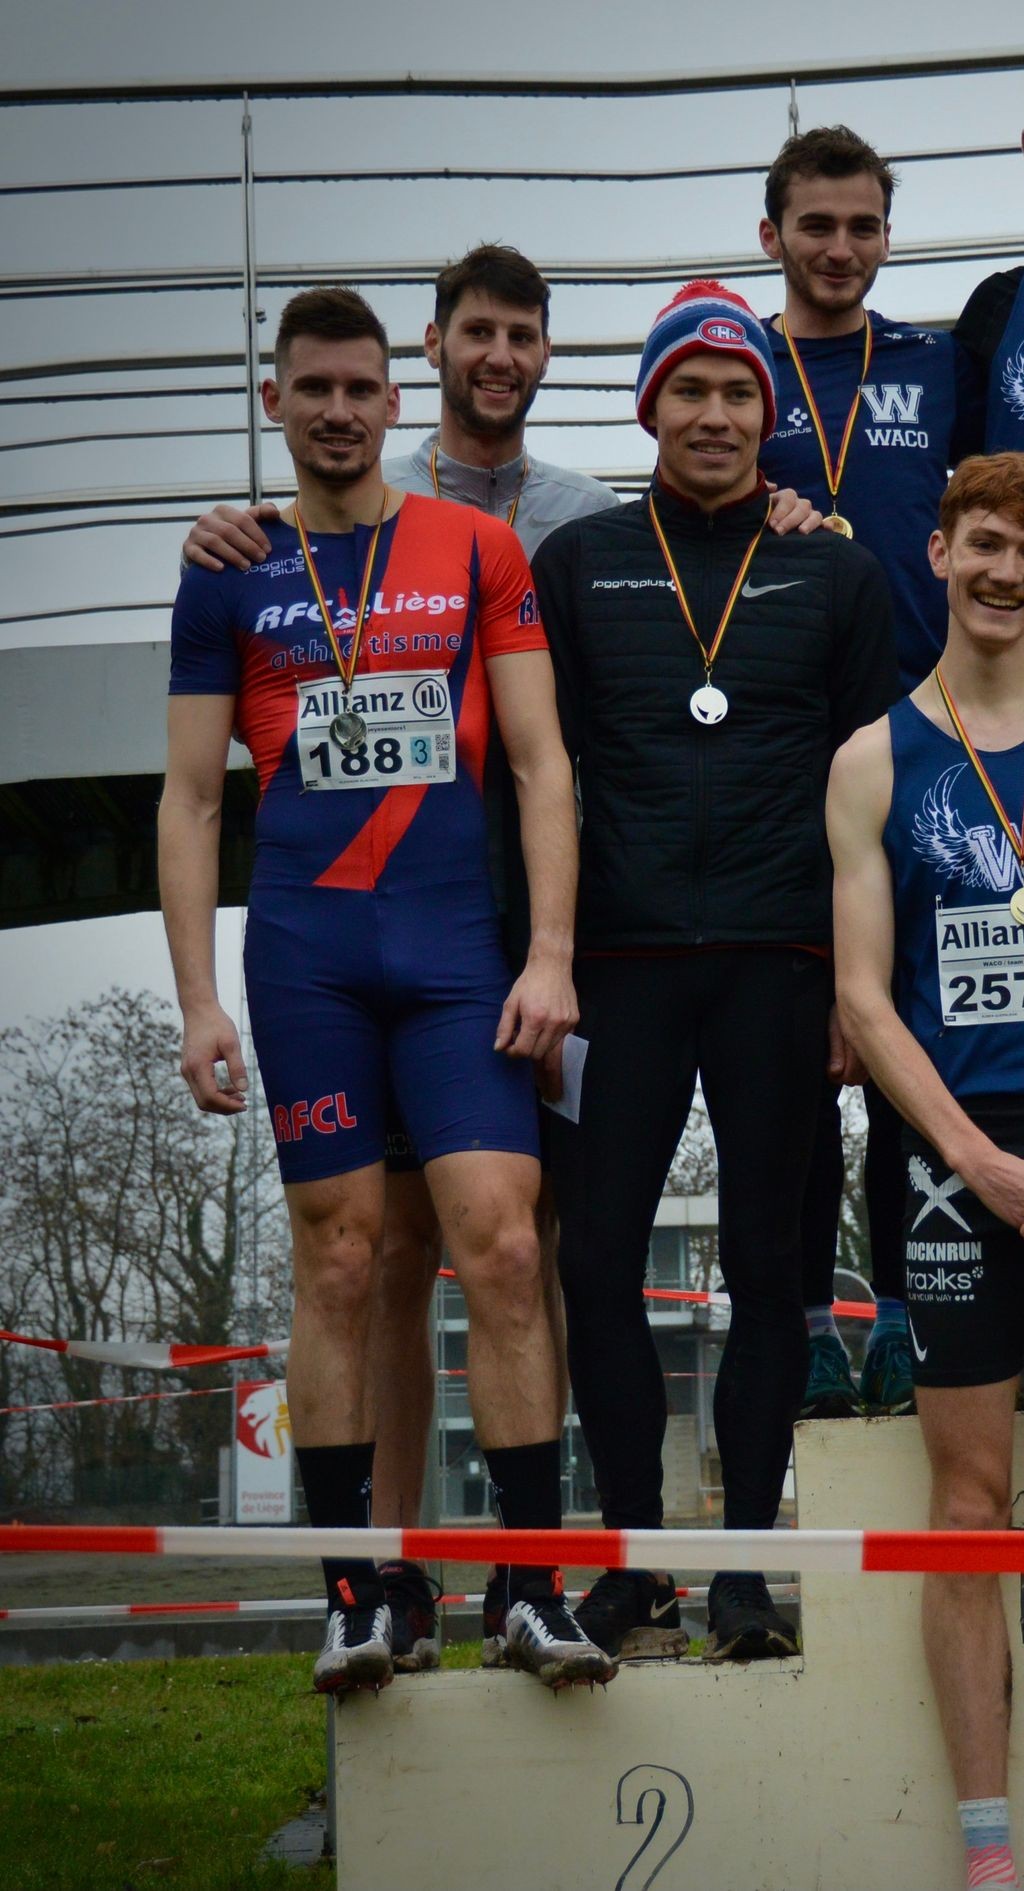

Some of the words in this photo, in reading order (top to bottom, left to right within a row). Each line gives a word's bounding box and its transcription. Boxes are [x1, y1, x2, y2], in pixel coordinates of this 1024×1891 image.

[858, 384, 923, 423] W
[865, 429, 929, 448] WACO
[270, 564, 305, 578] plus
[592, 579, 666, 589] joggingplus
[255, 600, 333, 634] RFC
[373, 591, 466, 615] Liège
[518, 589, 541, 626] R
[301, 690, 405, 719] Allianz
[309, 737, 404, 778] 188
[414, 740, 428, 765] 3
[983, 959, 1003, 968] WACO
[274, 1091, 357, 1143] RFCL
[906, 1241, 982, 1261] ROCKNRUN
[906, 1266, 972, 1290] trakks
[241, 1490, 285, 1500] Province
[241, 1503, 255, 1513] de
[257, 1502, 285, 1515] Liège
[615, 1764, 695, 1891] 2
